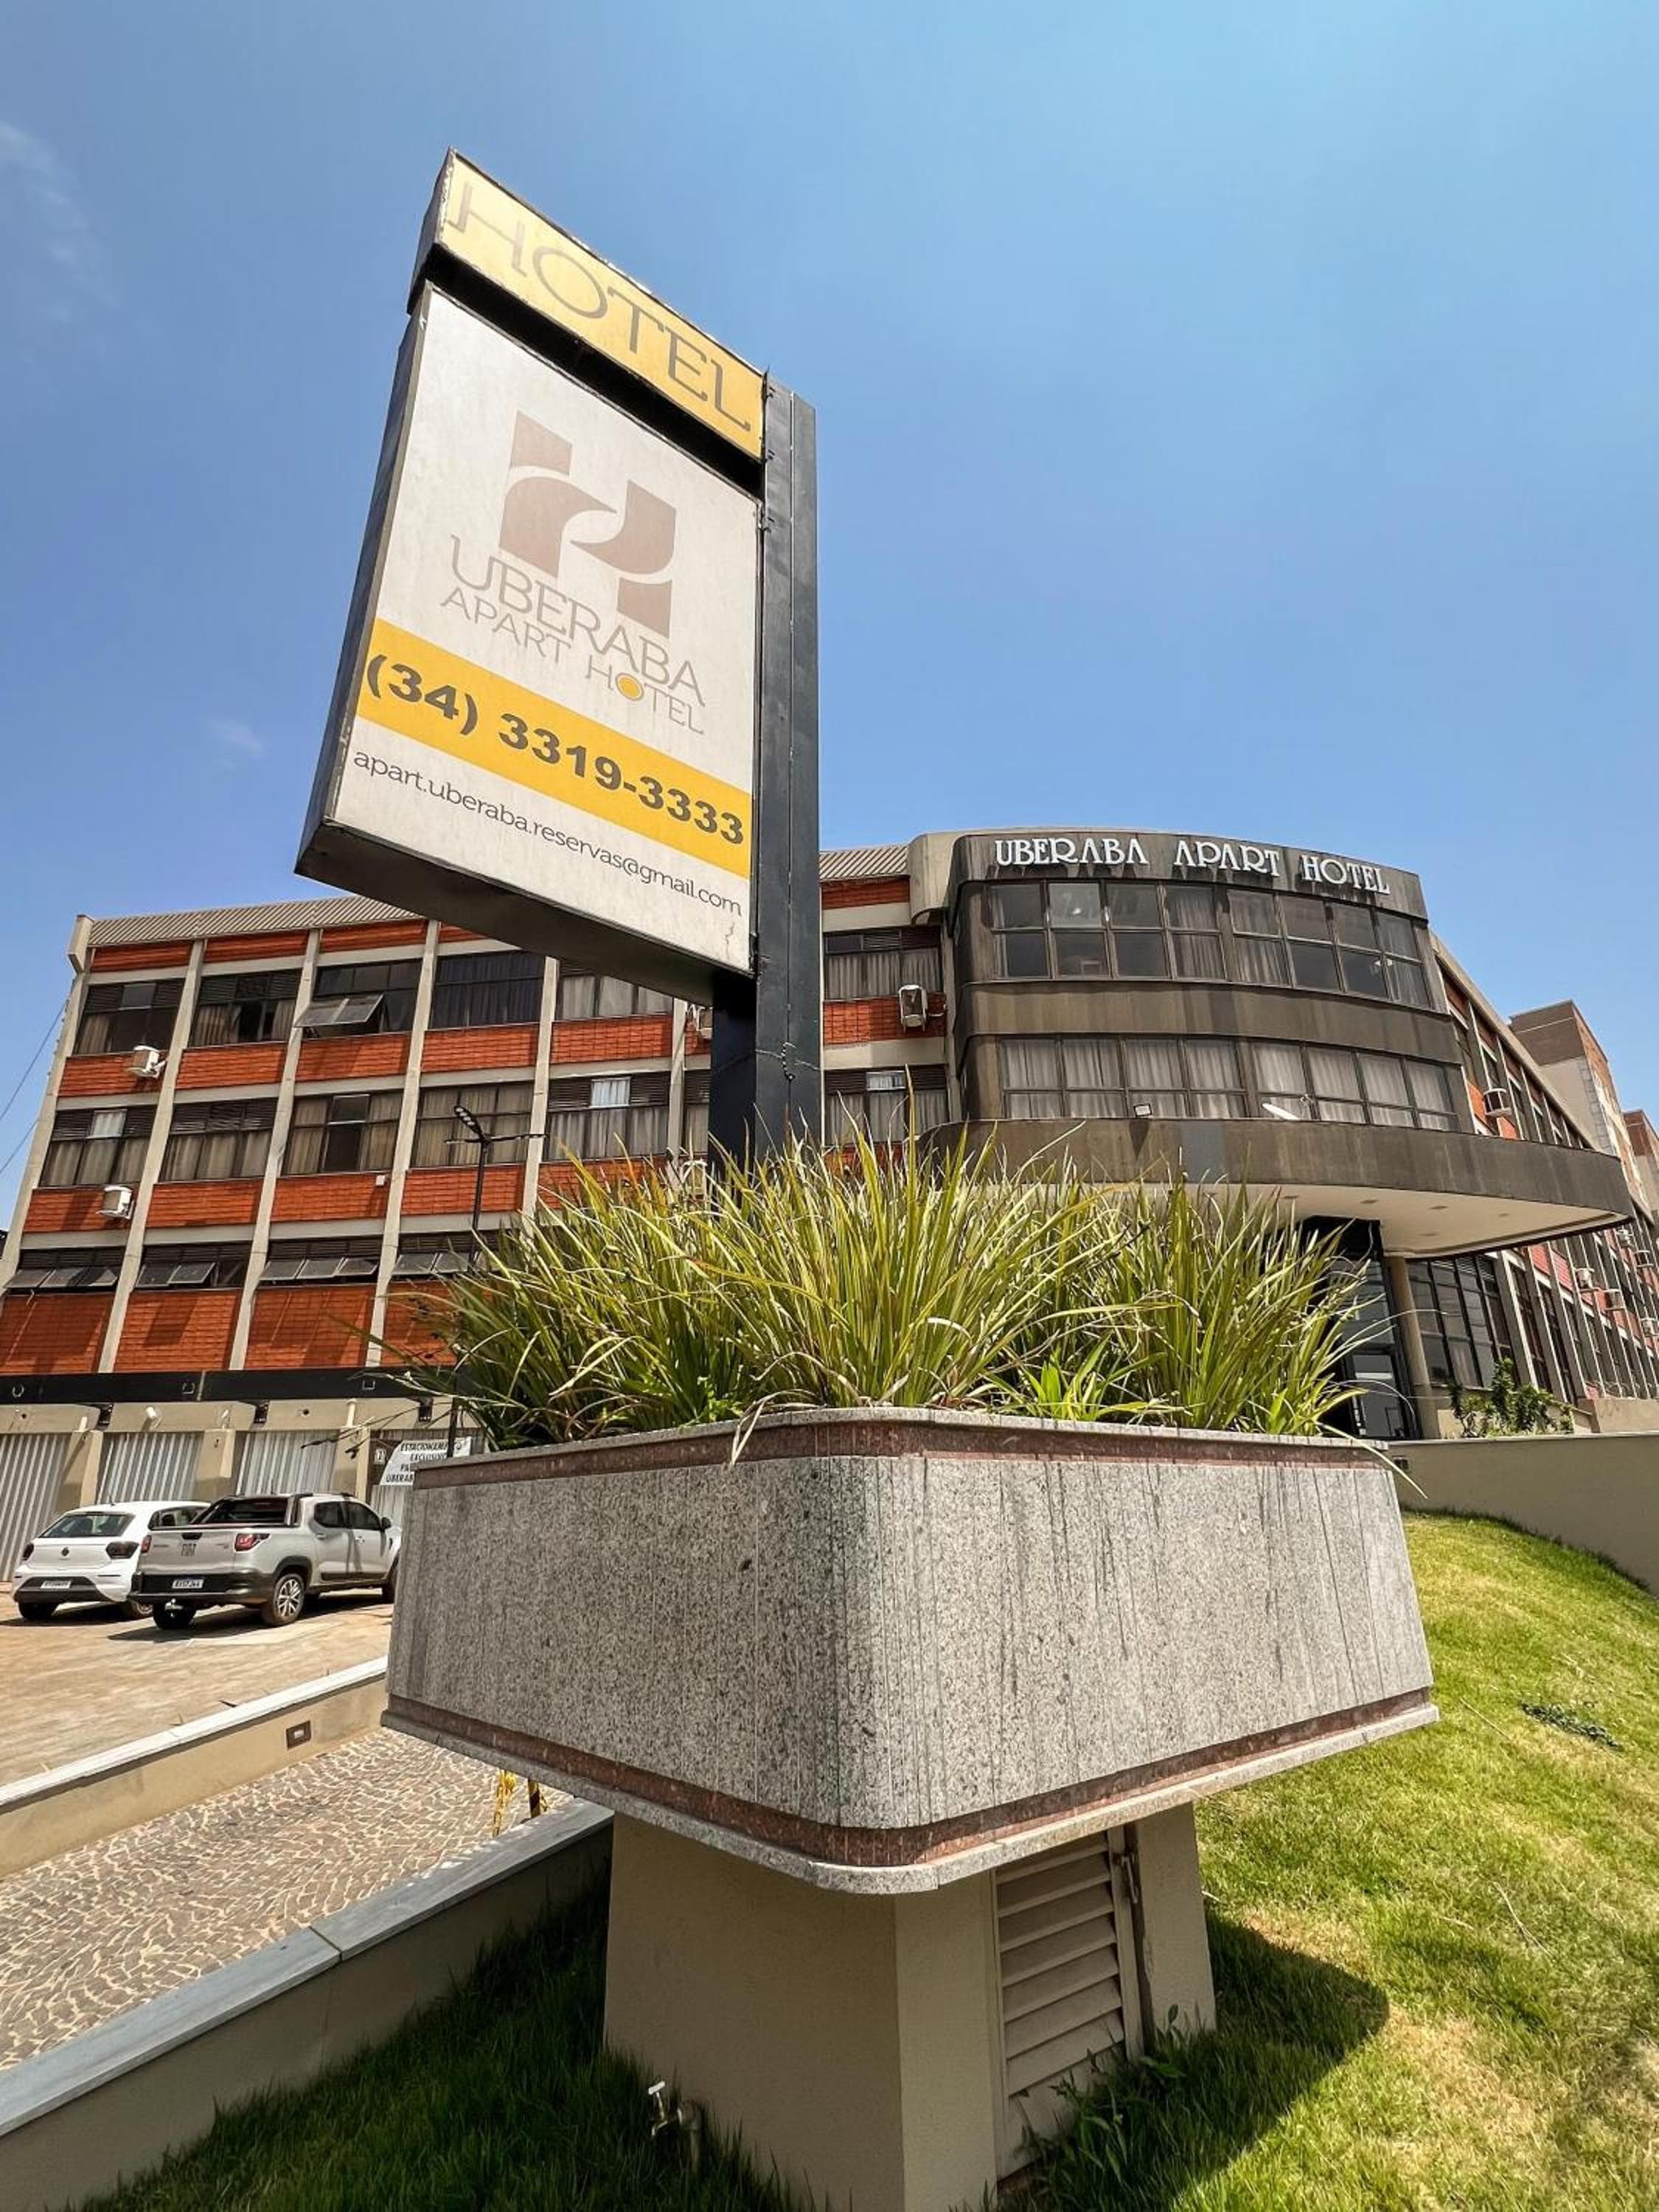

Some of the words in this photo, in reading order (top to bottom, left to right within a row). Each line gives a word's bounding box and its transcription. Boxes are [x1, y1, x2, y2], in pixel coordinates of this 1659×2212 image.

[445, 181, 751, 431] HOTEL
[439, 587, 571, 664] APART
[585, 654, 705, 736] HOTEL
[449, 535, 706, 708] UBERABA
[353, 748, 742, 917] apart.uberaba.reservas@gmail.com
[366, 654, 479, 736] (34)
[498, 713, 744, 846] 3319-3333
[994, 838, 1149, 866] UBERABA
[1174, 839, 1280, 877] APART
[1301, 854, 1391, 895] HOTEL
[400, 1441, 462, 1451] ESTACIONAMO
